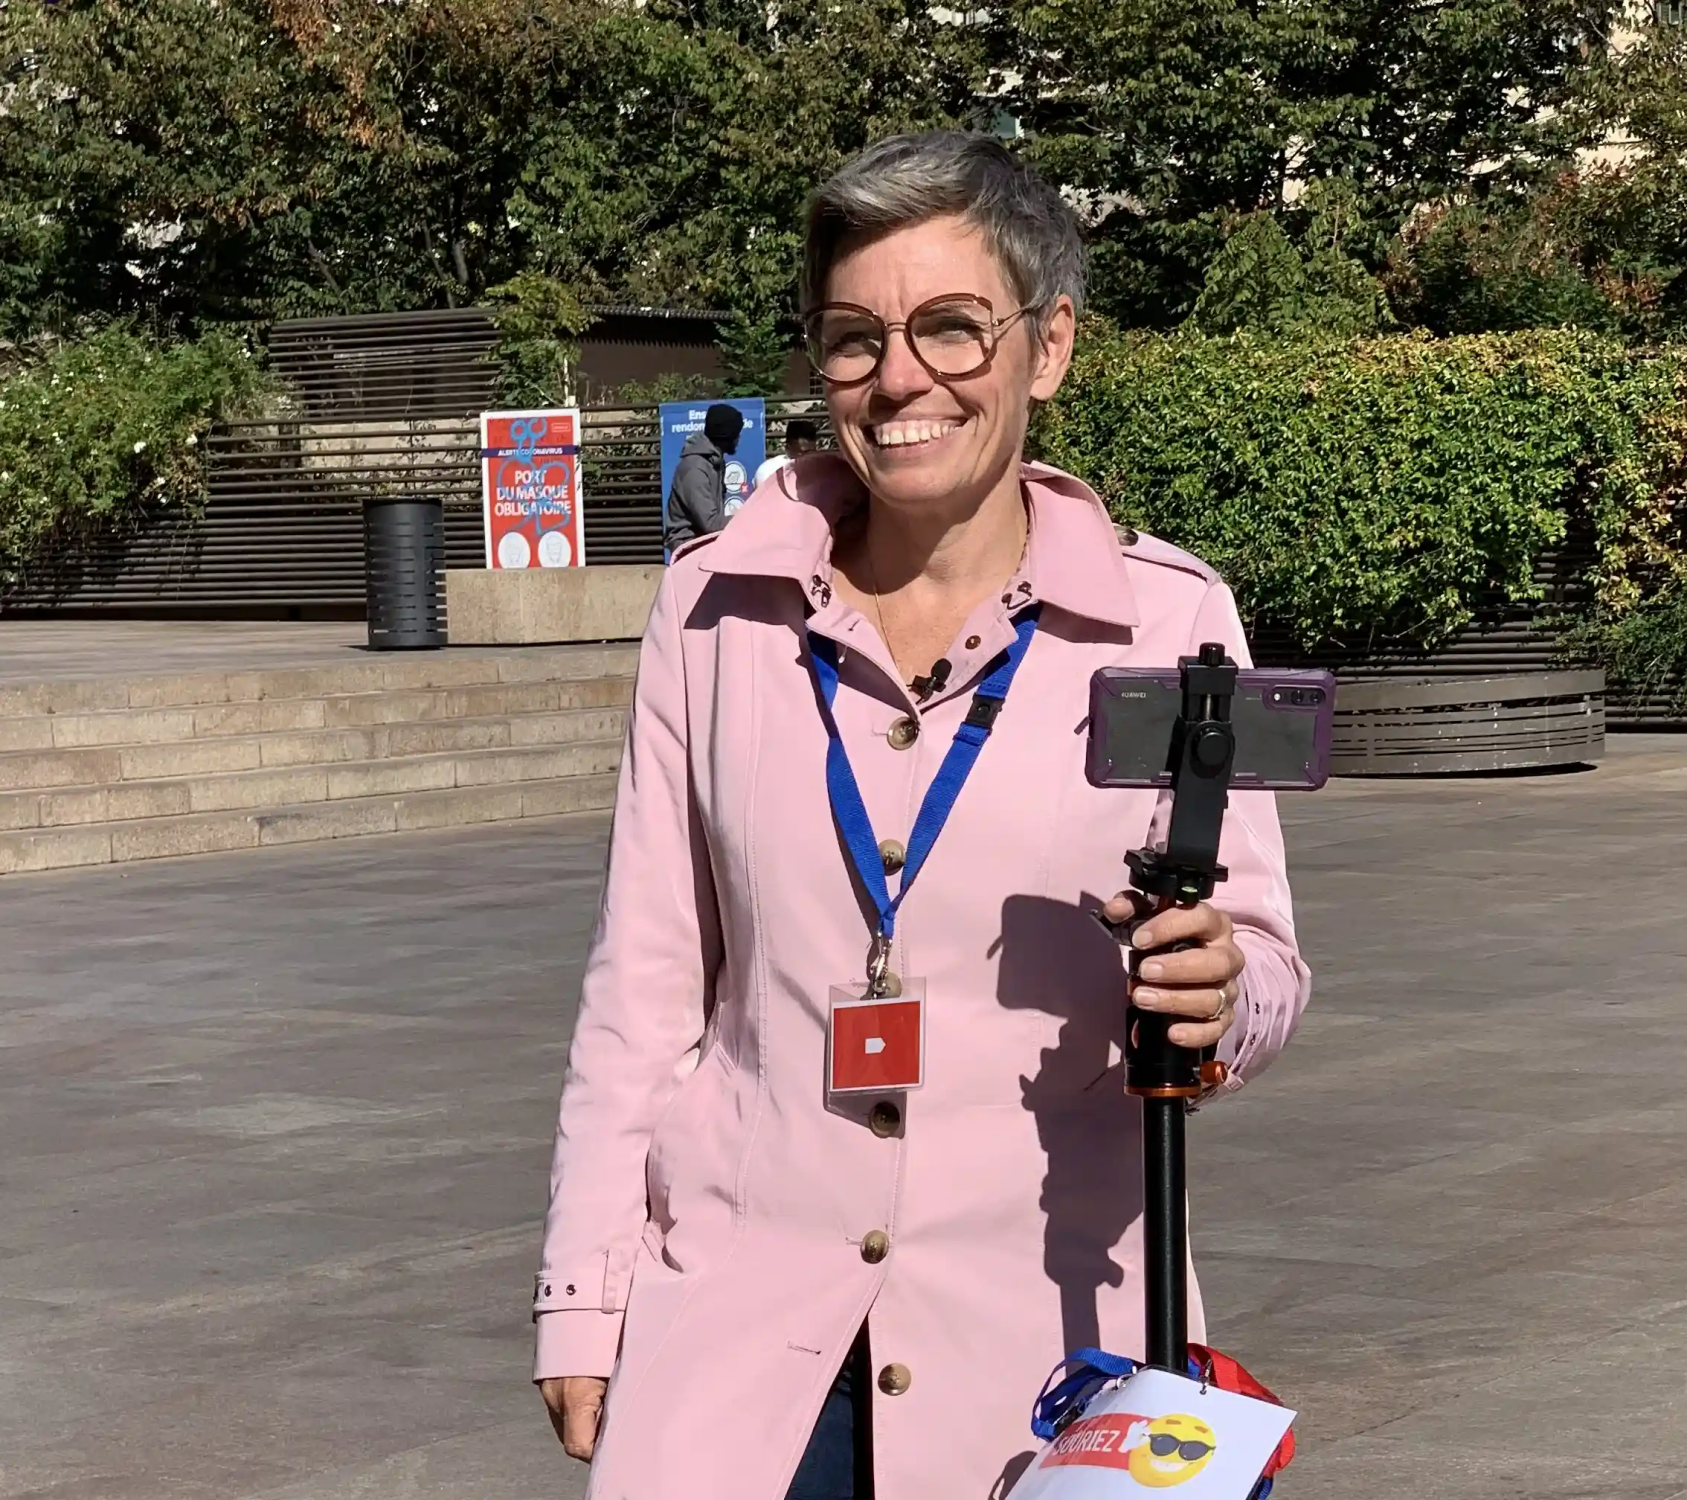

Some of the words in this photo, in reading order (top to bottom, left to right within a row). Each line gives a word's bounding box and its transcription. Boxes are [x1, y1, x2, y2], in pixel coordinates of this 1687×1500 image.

[671, 421, 706, 433] rendon
[515, 470, 547, 484] PORT
[497, 486, 514, 501] DU
[516, 485, 569, 501] MASQUE
[494, 500, 572, 516] OBLIGATOIRE
[1053, 1429, 1120, 1455] SOURIEZ
